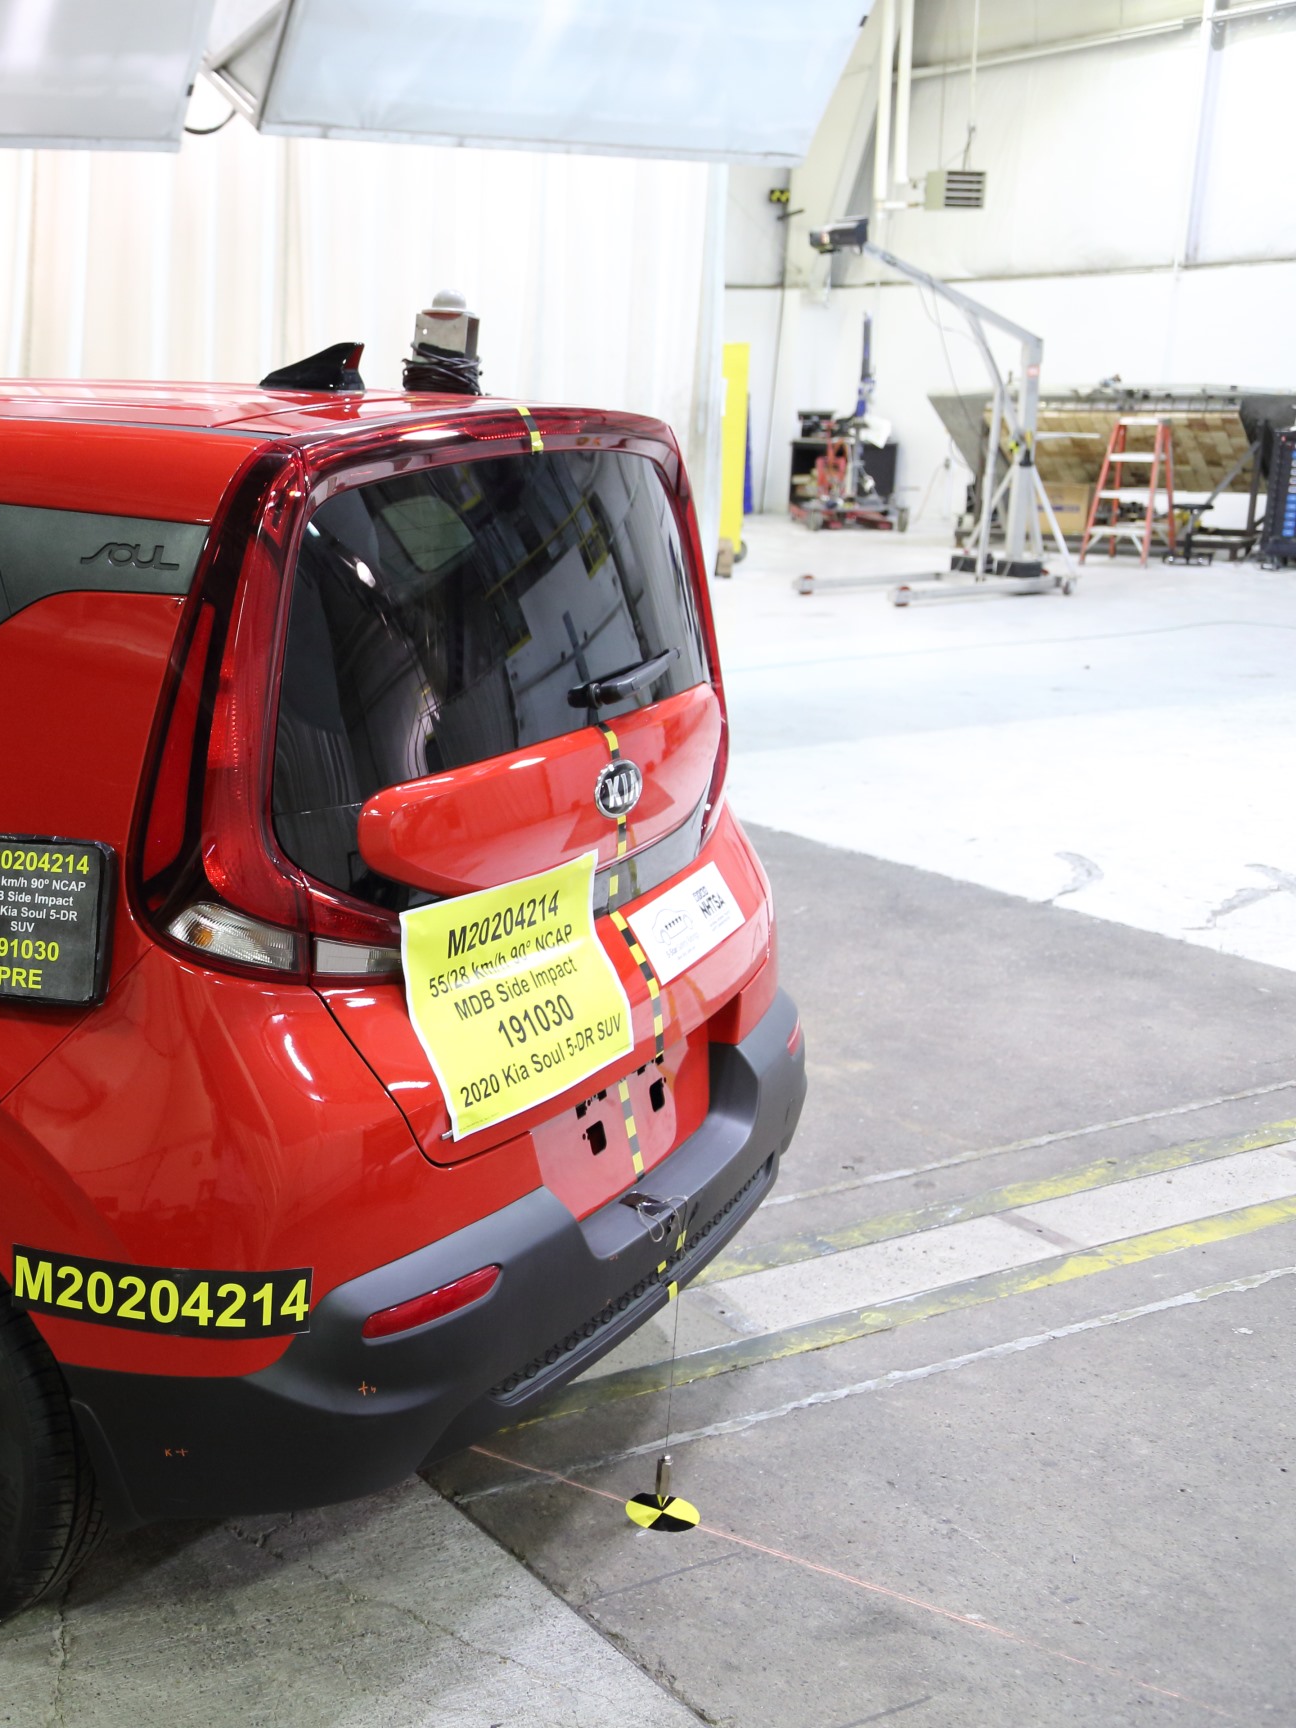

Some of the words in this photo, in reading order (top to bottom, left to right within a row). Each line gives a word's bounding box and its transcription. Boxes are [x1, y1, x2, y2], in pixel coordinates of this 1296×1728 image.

[80, 542, 180, 571] SOUL
[604, 769, 640, 808] KIA
[1, 876, 28, 888] km/h
[52, 880, 86, 892] NCAP
[7, 891, 32, 903] Side
[34, 893, 74, 907] Impact
[0, 905, 18, 917] Kia
[20, 907, 46, 919] Soul
[49, 909, 78, 921] 5-DR
[10, 921, 35, 933] SUV
[447, 889, 560, 959] M20204214
[429, 965, 471, 998] 55/28
[471, 952, 507, 980] km/h
[535, 923, 573, 952] NCAP
[454, 989, 495, 1021] MDB
[496, 977, 531, 1003] Side
[529, 956, 577, 987] Impact
[498, 994, 574, 1048] 191030
[460, 1073, 500, 1108] 2020
[502, 1063, 530, 1088] Kia
[530, 1042, 565, 1073] Soul
[565, 1027, 595, 1057] 5-DR
[597, 1013, 621, 1041] SUV
[14, 1255, 309, 1328] M20204214
